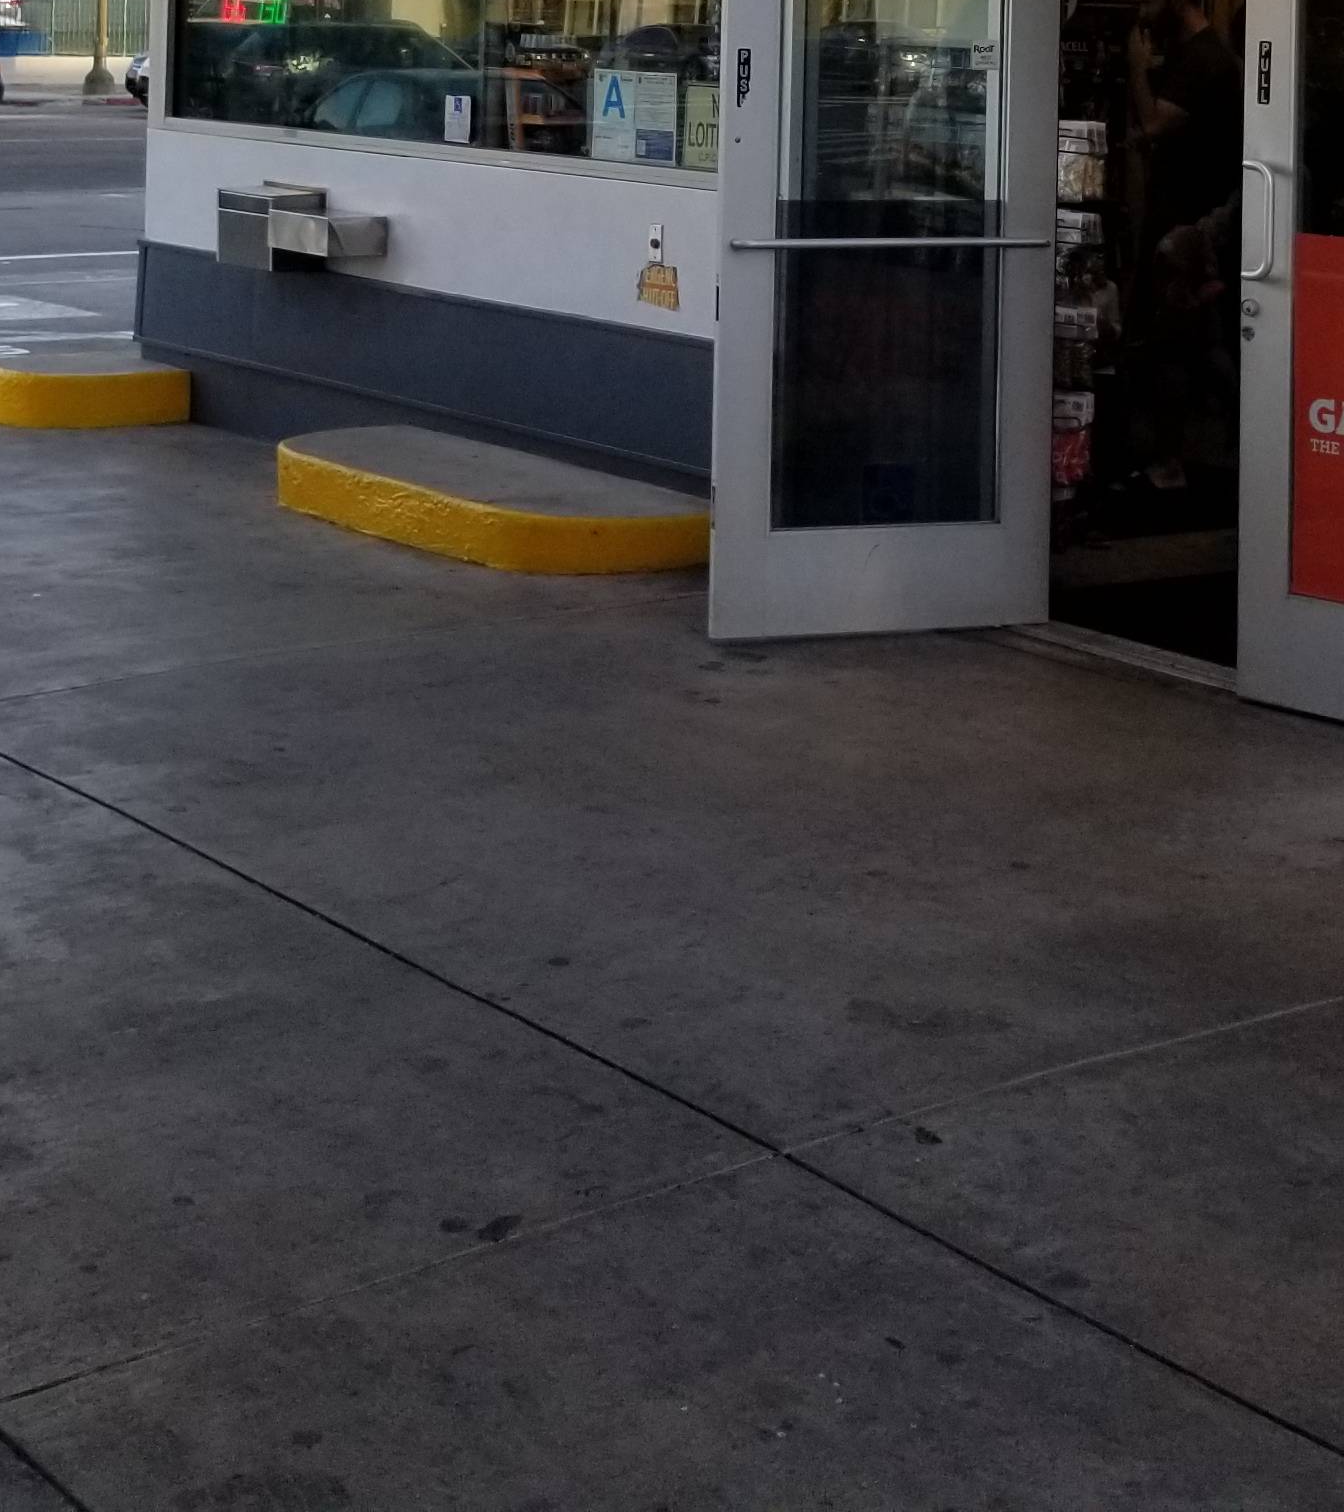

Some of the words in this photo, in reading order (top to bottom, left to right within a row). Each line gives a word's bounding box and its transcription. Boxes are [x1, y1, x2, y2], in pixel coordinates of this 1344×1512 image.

[1260, 42, 1270, 103] PULL
[602, 75, 626, 119] A
[687, 121, 720, 149] LOIT
[1310, 438, 1340, 455] THE
